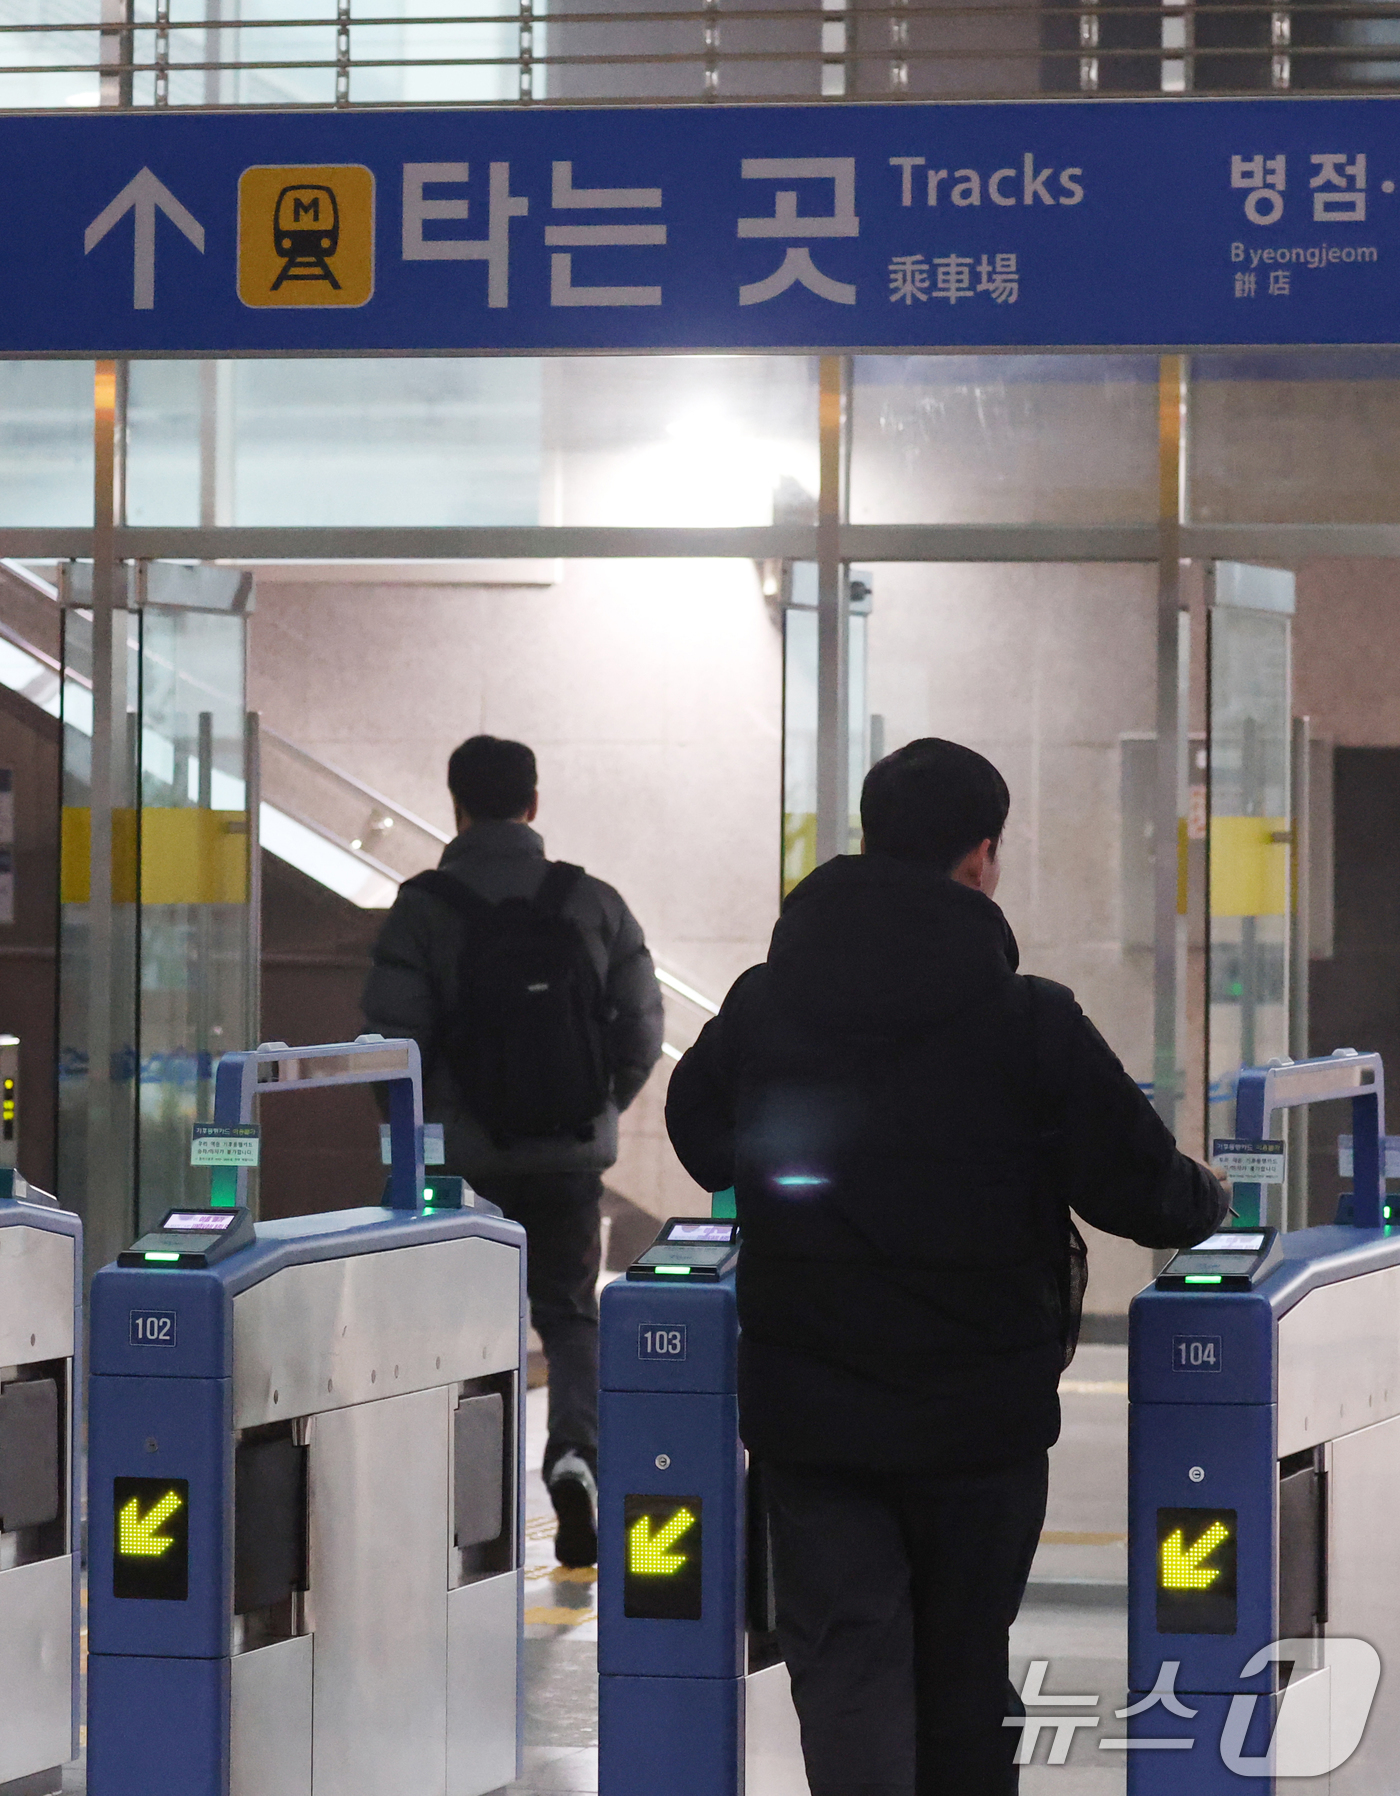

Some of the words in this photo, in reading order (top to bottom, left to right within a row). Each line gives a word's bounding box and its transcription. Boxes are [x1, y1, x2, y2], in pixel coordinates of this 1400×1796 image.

[889, 152, 1084, 207] Tracks
[402, 160, 667, 309] 타는
[738, 157, 860, 306] 곳
[1231, 242, 1378, 268] Byeongjeom
[888, 253, 1019, 305] 乘車場
[136, 1317, 171, 1340] 102
[644, 1331, 681, 1354] 103
[1178, 1342, 1216, 1365] 104
